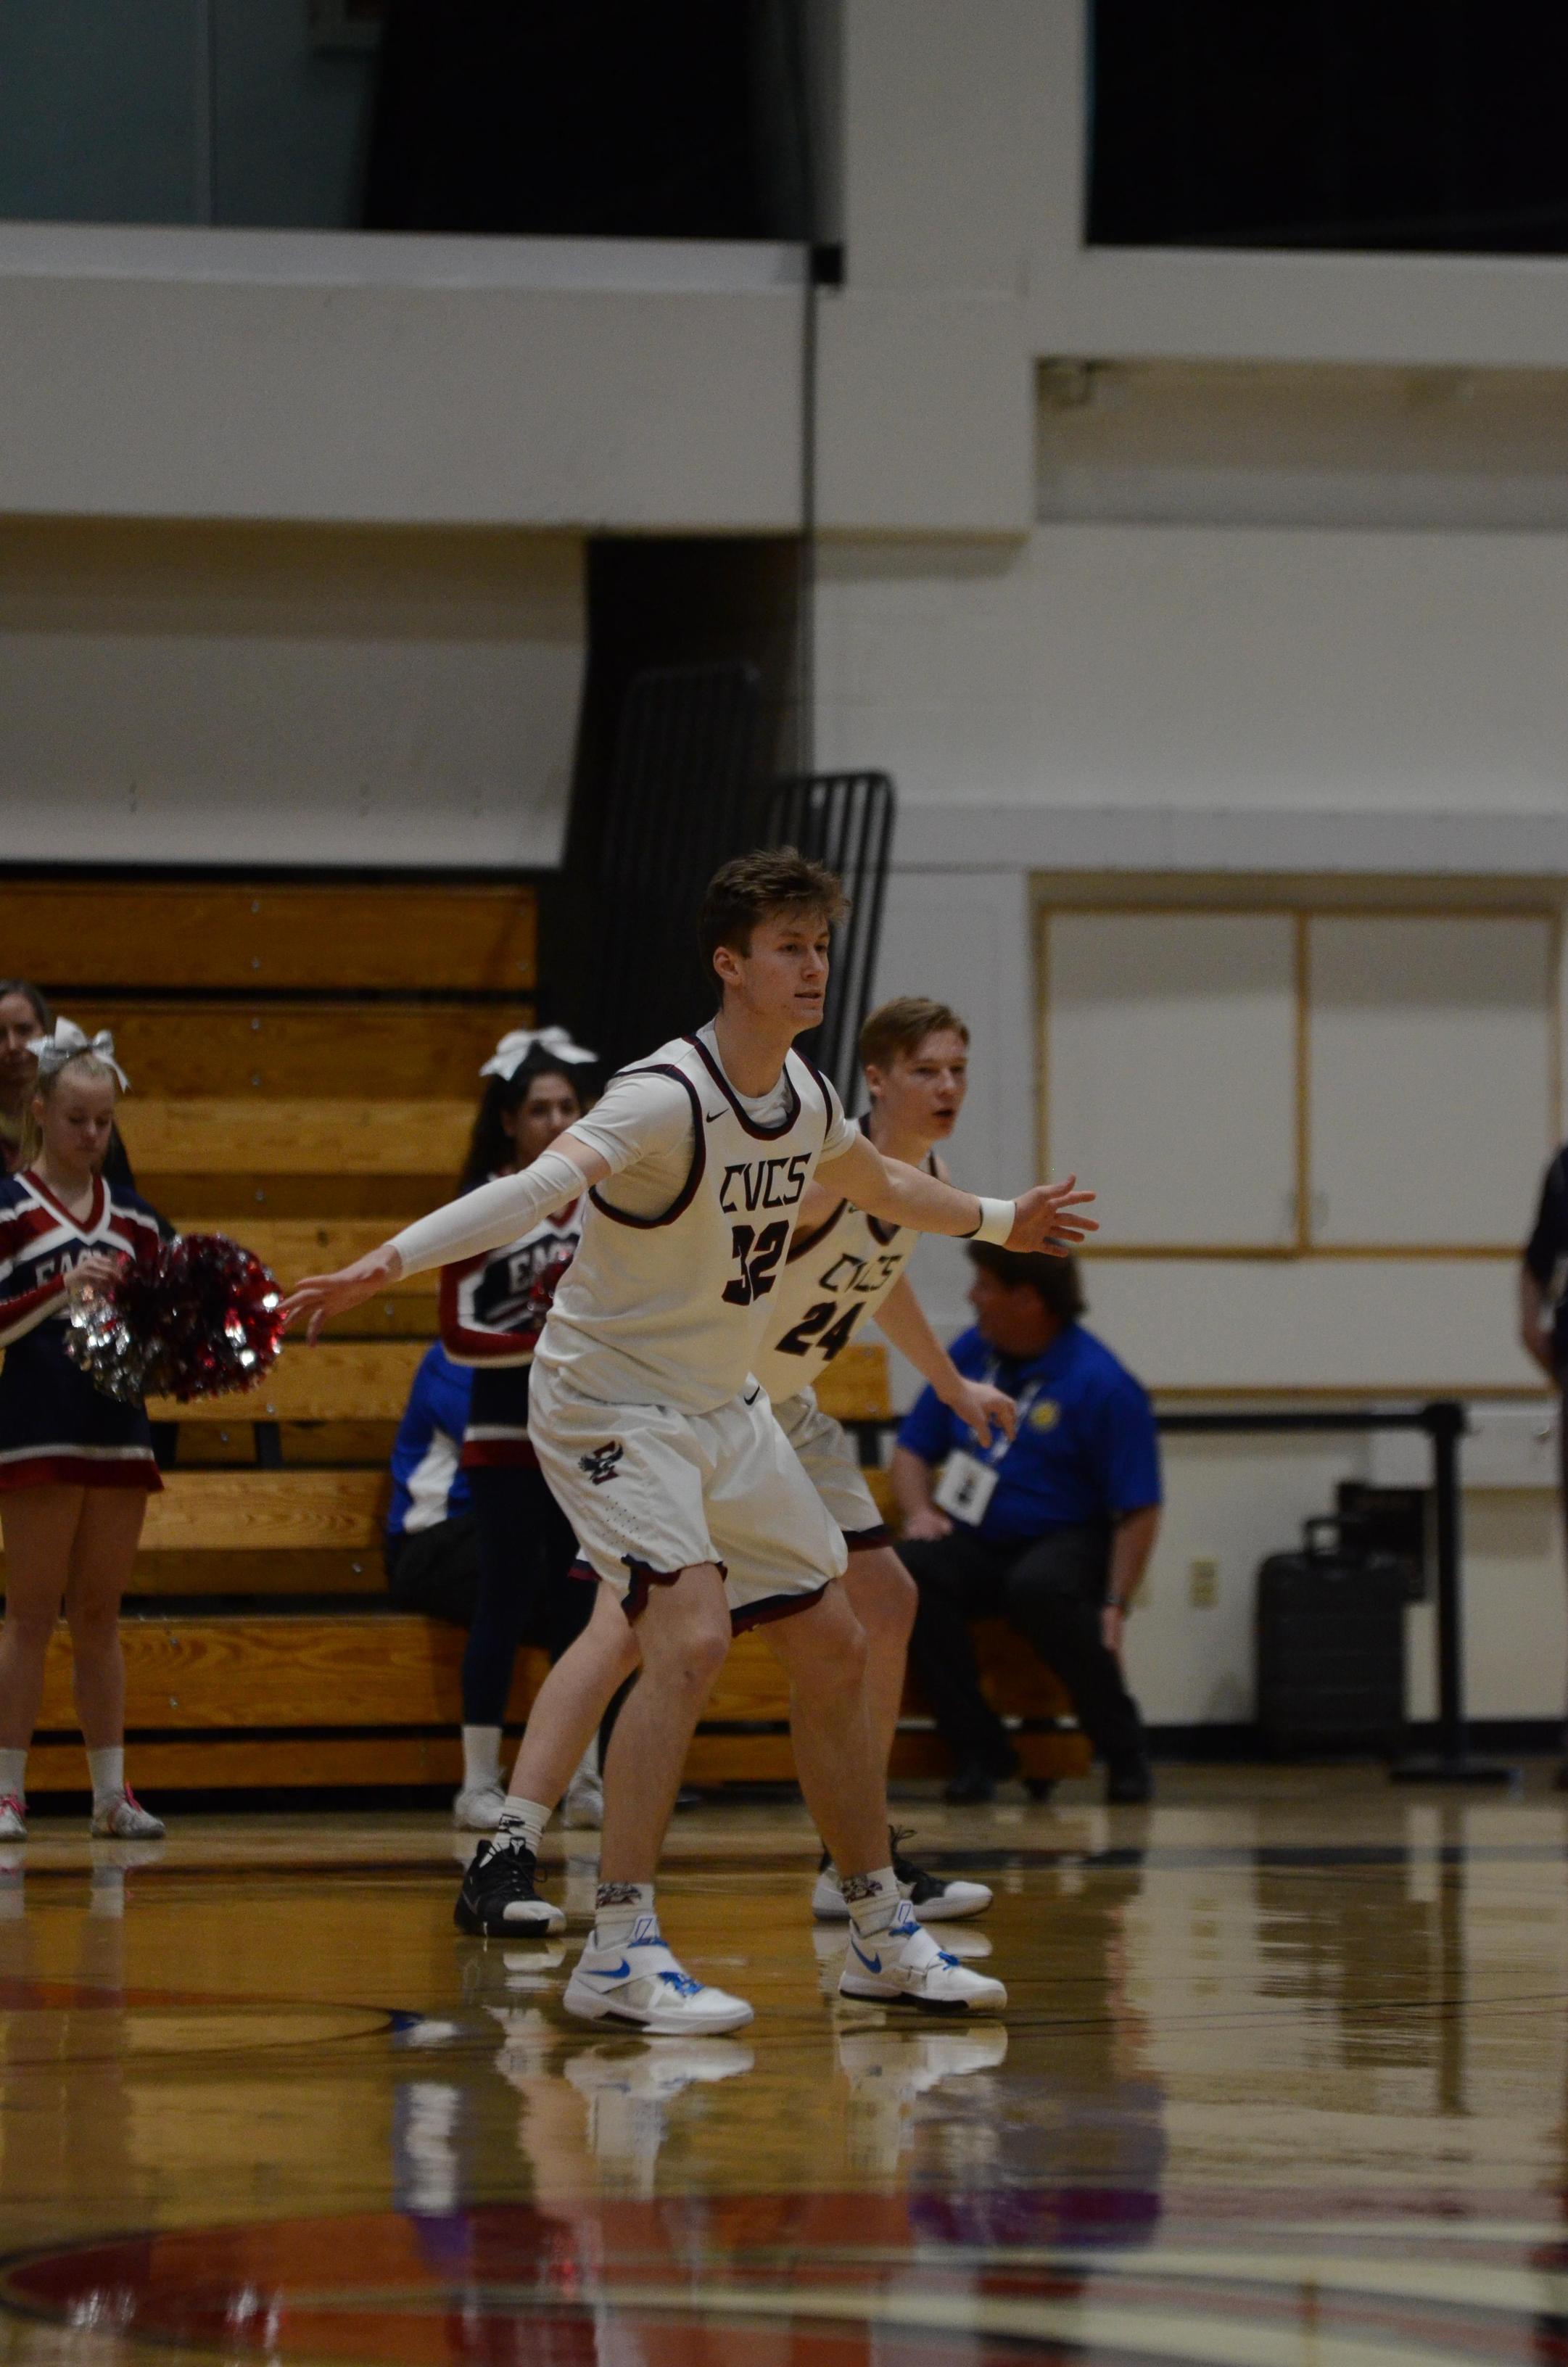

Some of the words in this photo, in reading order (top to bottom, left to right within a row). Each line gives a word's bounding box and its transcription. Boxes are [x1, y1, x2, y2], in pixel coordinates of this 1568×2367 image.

[719, 1152, 812, 1213] CVCS
[722, 1220, 789, 1305] 32
[775, 1302, 866, 1360] 24
